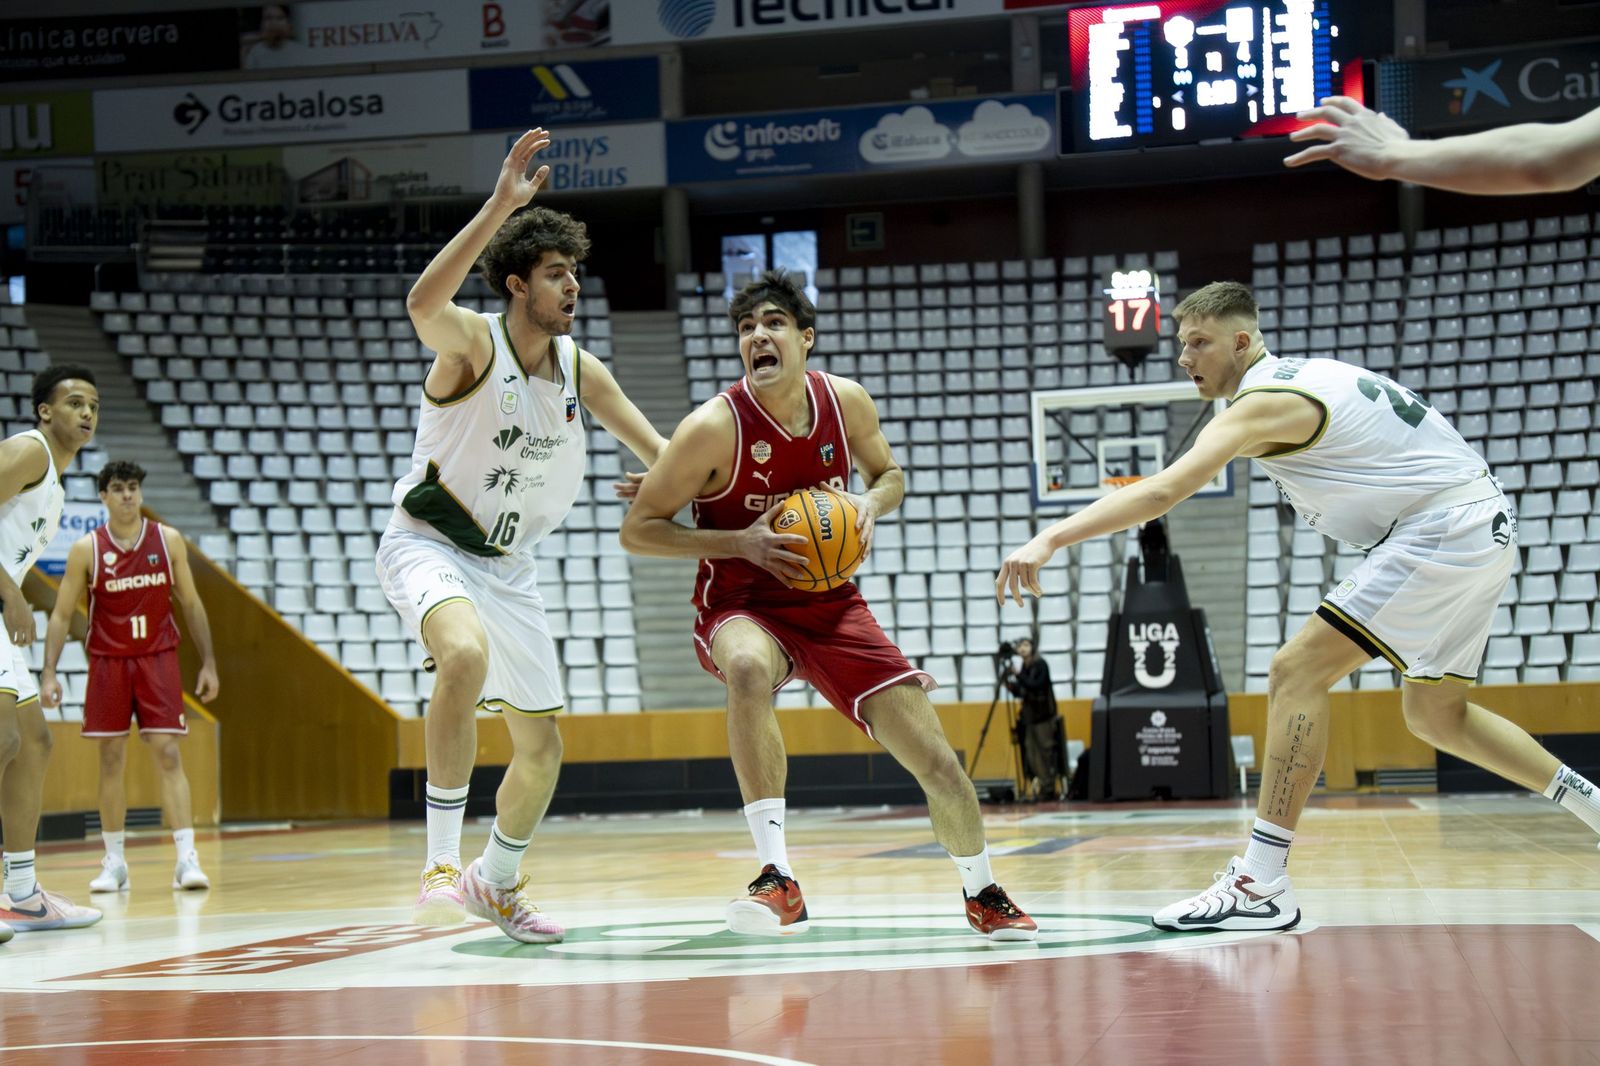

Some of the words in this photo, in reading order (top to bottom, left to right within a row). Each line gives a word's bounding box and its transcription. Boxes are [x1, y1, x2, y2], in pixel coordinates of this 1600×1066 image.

[481, 3, 505, 38] B
[734, 0, 956, 27] Tecn
[0, 27, 77, 51] ínica
[81, 23, 180, 48] cervera
[306, 21, 420, 48] FRISELVA
[217, 90, 384, 123] Grabalosa
[744, 118, 841, 147] infosoft
[506, 136, 609, 165] tanys
[553, 164, 628, 190] Blaus
[1108, 299, 1151, 331] 17
[743, 475, 845, 513] GIRA
[486, 511, 521, 547] 16
[104, 571, 168, 593] GIRONA
[129, 615, 148, 640] 11
[1128, 622, 1180, 642] LIGA
[1275, 713, 1307, 817] DISCIPLINA
[1562, 771, 1594, 799] UNICAJA
